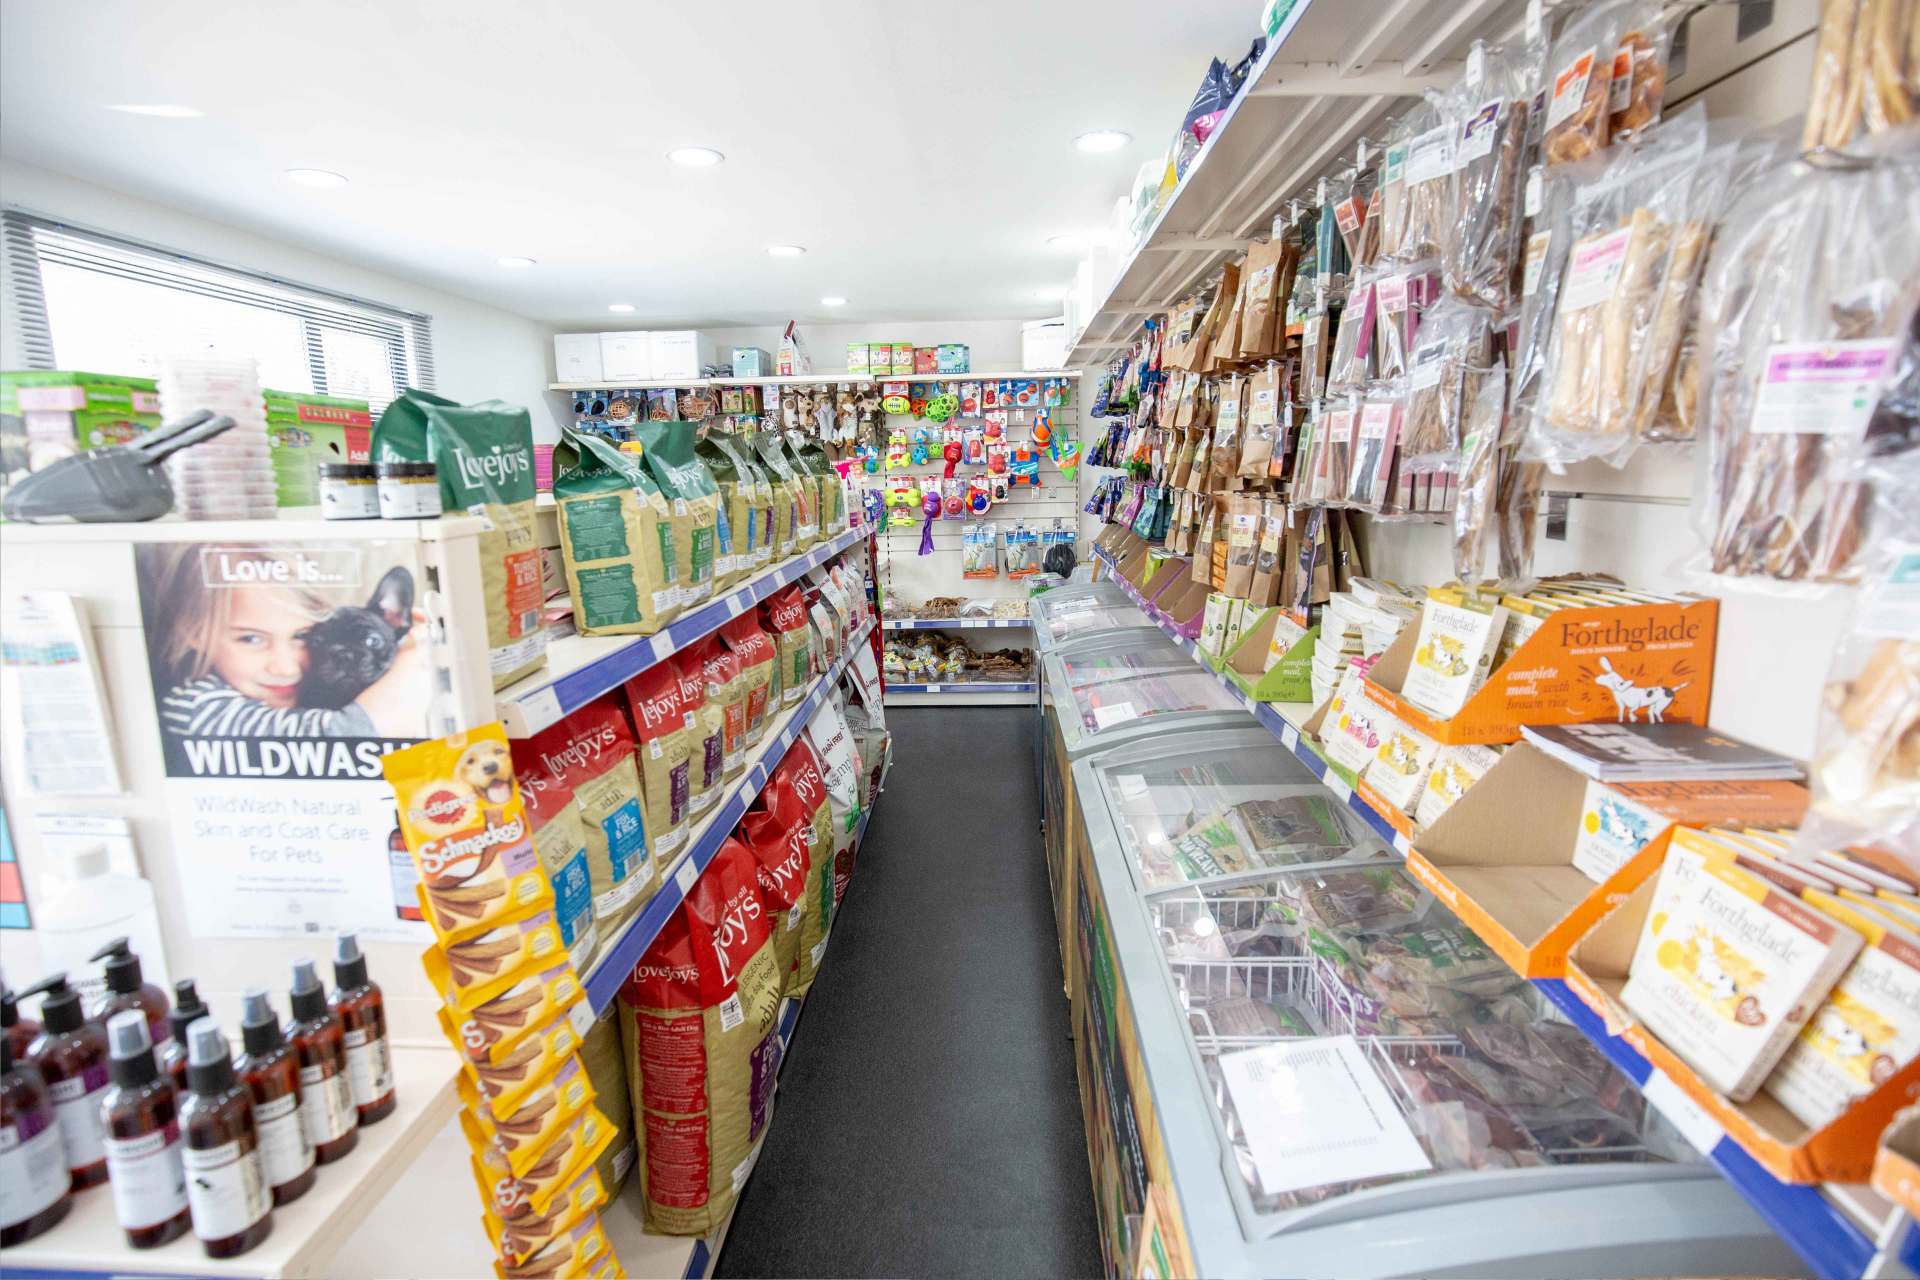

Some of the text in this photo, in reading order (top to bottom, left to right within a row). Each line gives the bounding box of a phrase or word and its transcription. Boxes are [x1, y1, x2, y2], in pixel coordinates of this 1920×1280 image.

[220, 554, 290, 582] Love
[1561, 615, 1700, 652] Forthglade
[1506, 667, 1559, 685] complete
[183, 740, 412, 778] WILDWAS
[541, 725, 617, 782] Lovejoys
[194, 796, 361, 816] WildWash Natural
[194, 819, 232, 838] Skin
[279, 822, 321, 841] Coat
[328, 822, 370, 842] Care
[419, 812, 526, 875] Schmackos
[285, 845, 323, 864] Pets
[1699, 887, 1798, 966] Forthglade
[633, 965, 700, 984] Lovejoys
